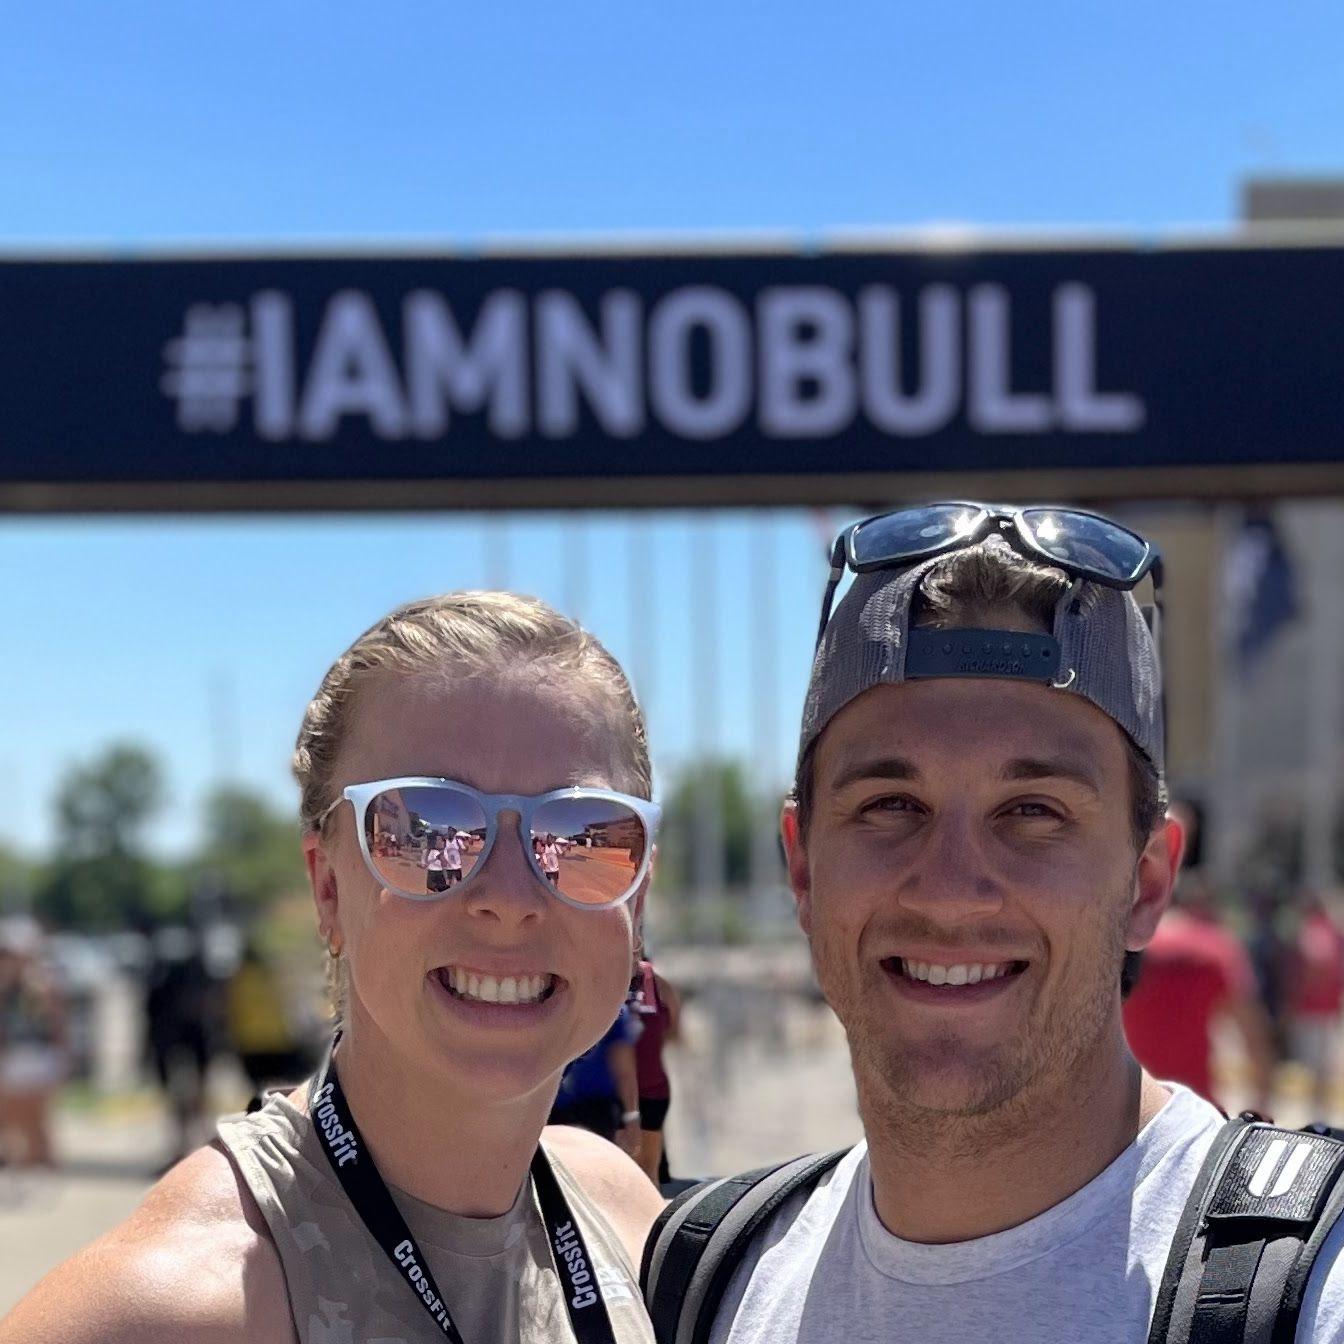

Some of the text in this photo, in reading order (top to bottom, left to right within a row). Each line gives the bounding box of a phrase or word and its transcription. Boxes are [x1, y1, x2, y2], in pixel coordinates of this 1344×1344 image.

[161, 281, 1145, 440] #IAMNOBULL
[313, 1082, 357, 1167] CrossFit
[394, 1239, 451, 1332] CrossFit
[555, 1221, 597, 1309] CrossFit
